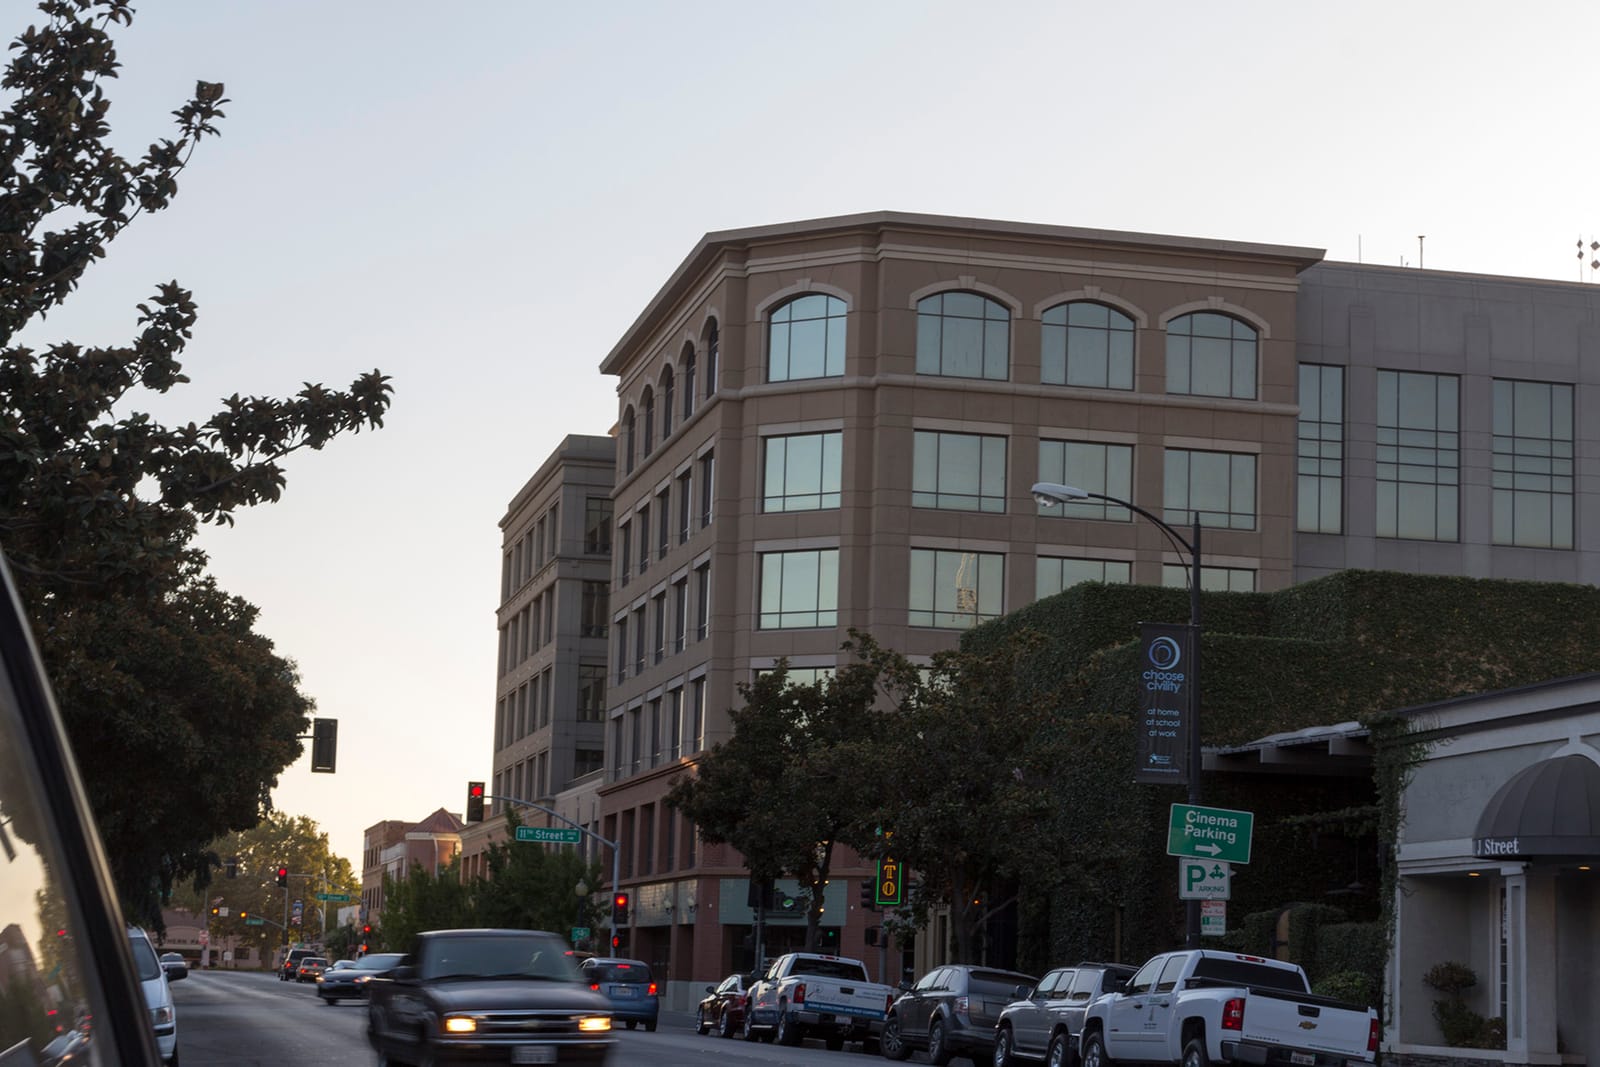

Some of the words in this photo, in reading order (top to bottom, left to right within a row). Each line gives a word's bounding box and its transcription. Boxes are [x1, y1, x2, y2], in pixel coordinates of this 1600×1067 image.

[1143, 671, 1184, 681] choose
[1147, 681, 1180, 693] civility
[1157, 708, 1179, 716] home
[1156, 719, 1181, 727] school
[1186, 811, 1237, 827] Cinema
[536, 830, 564, 840] Street
[1184, 825, 1236, 844] Parking
[1477, 839, 1482, 855] J
[1485, 838, 1519, 855] Street
